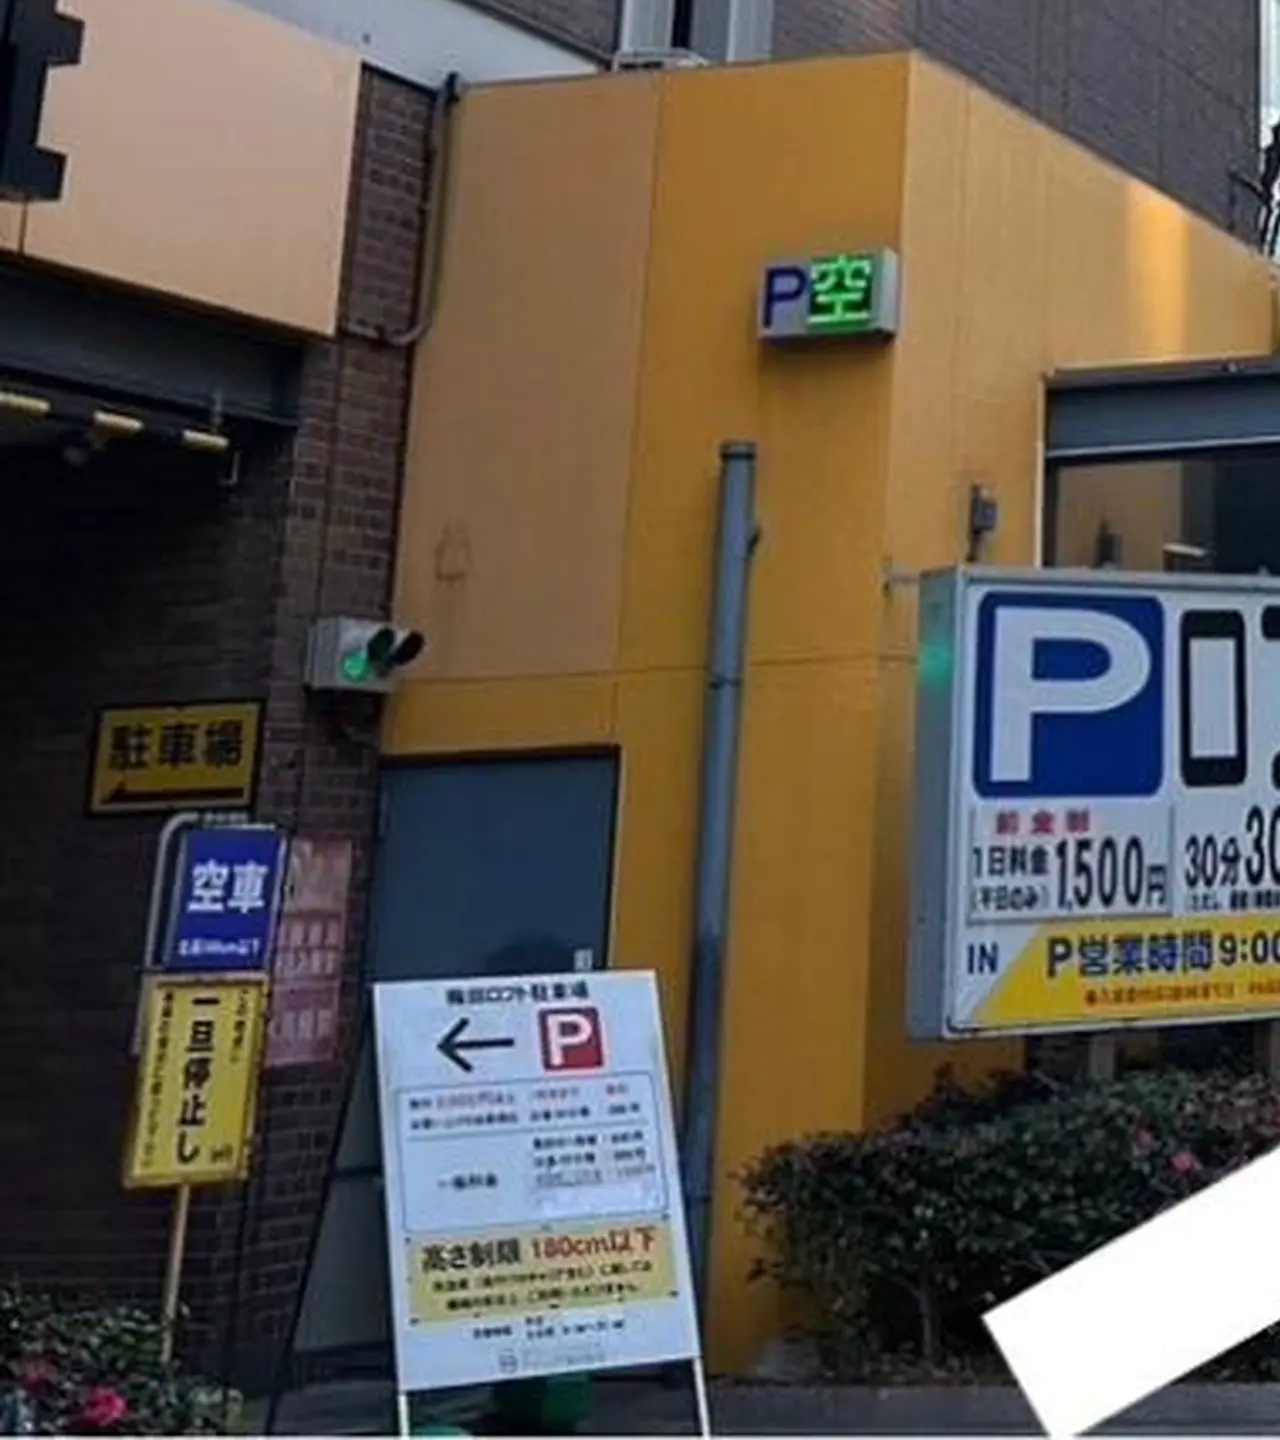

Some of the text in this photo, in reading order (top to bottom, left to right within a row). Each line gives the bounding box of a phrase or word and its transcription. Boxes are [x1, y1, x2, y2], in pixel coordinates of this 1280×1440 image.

[989, 606, 1152, 784] P
[107, 719, 245, 770] 駐車場
[187, 858, 268, 914] 空車
[967, 941, 998, 976] IN
[546, 1014, 592, 1066] P
